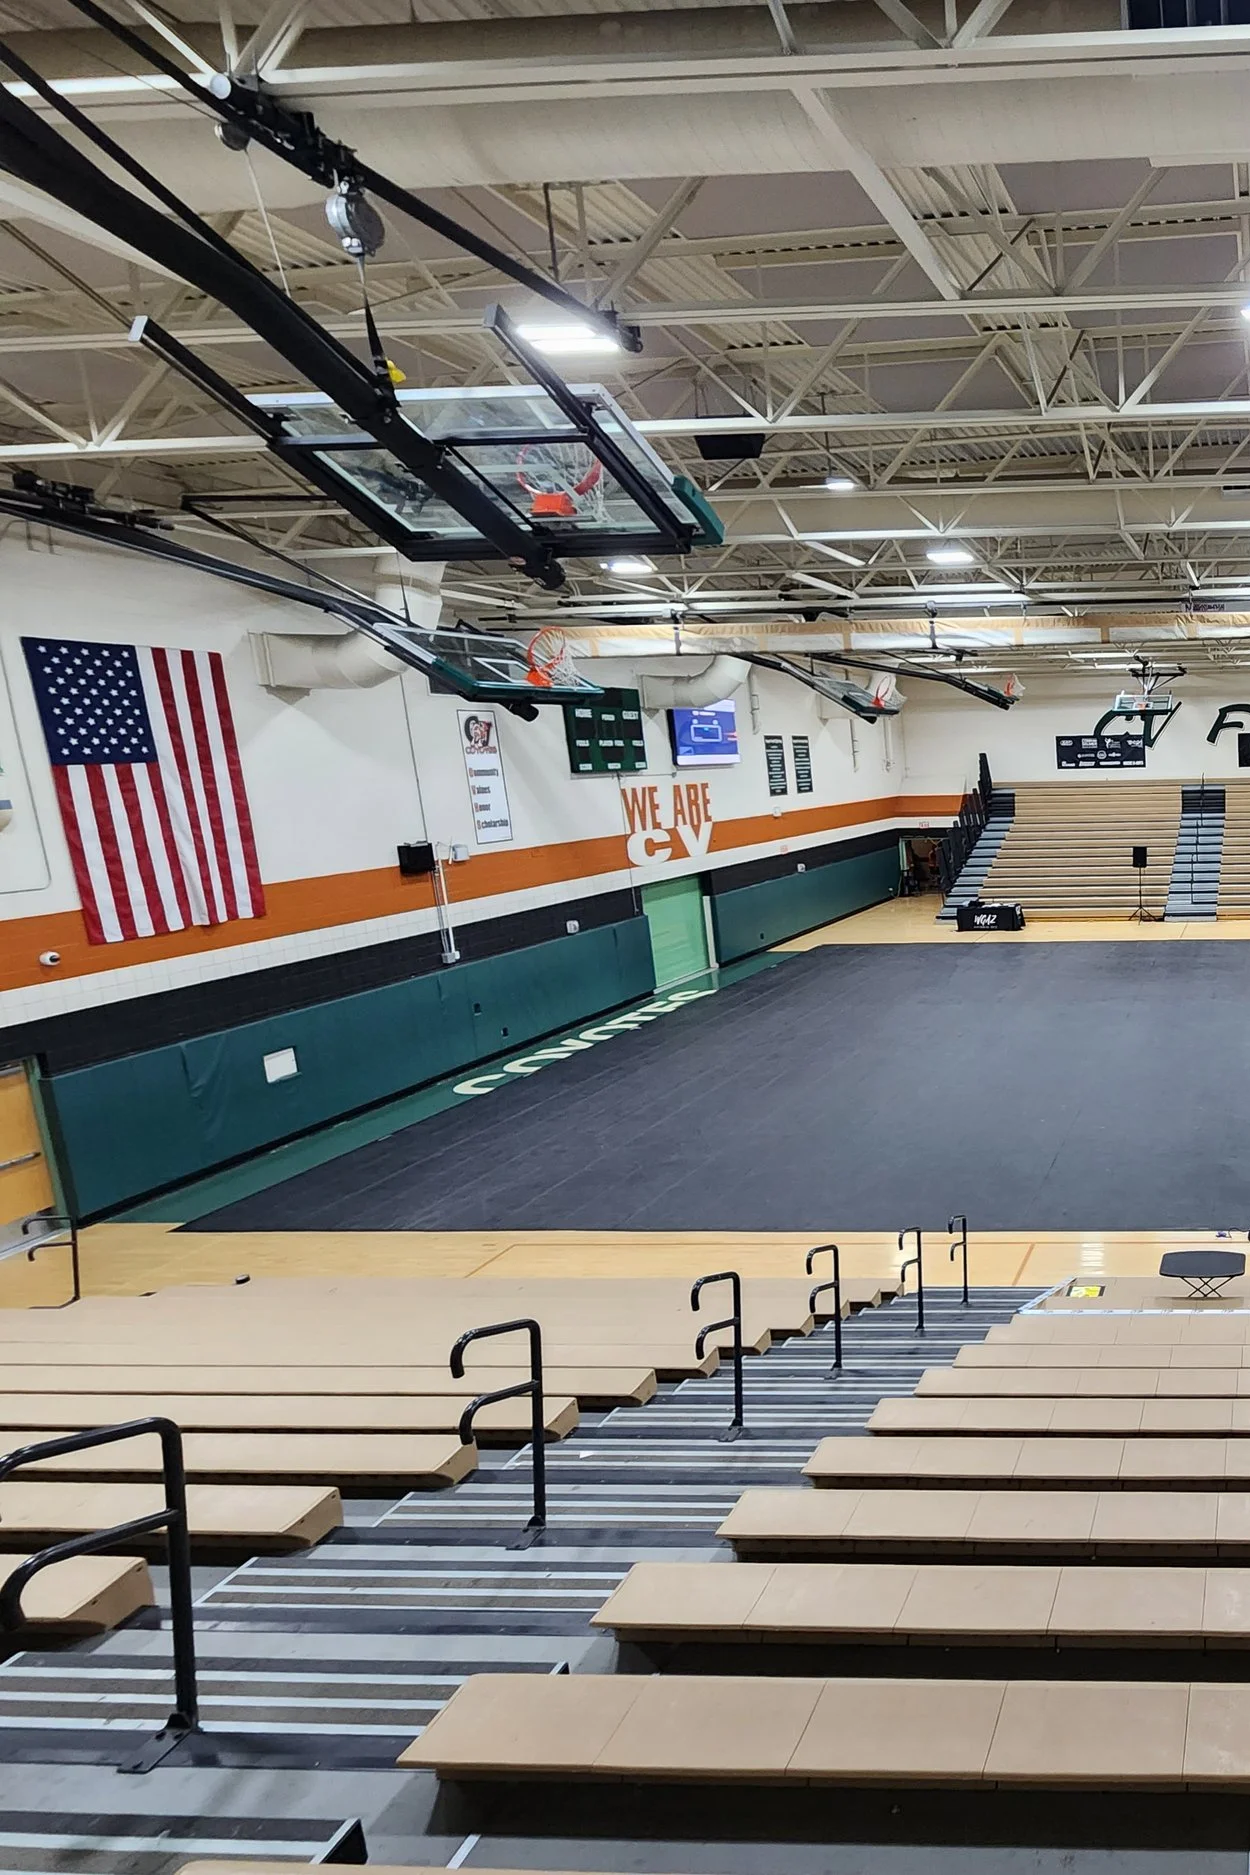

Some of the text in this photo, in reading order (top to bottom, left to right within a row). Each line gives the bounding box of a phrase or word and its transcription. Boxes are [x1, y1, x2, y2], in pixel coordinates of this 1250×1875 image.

[621, 782, 713, 834] WE ARE
[477, 819, 509, 830] Scholarship
[627, 821, 714, 867] CV
[974, 914, 998, 926] WGAZ
